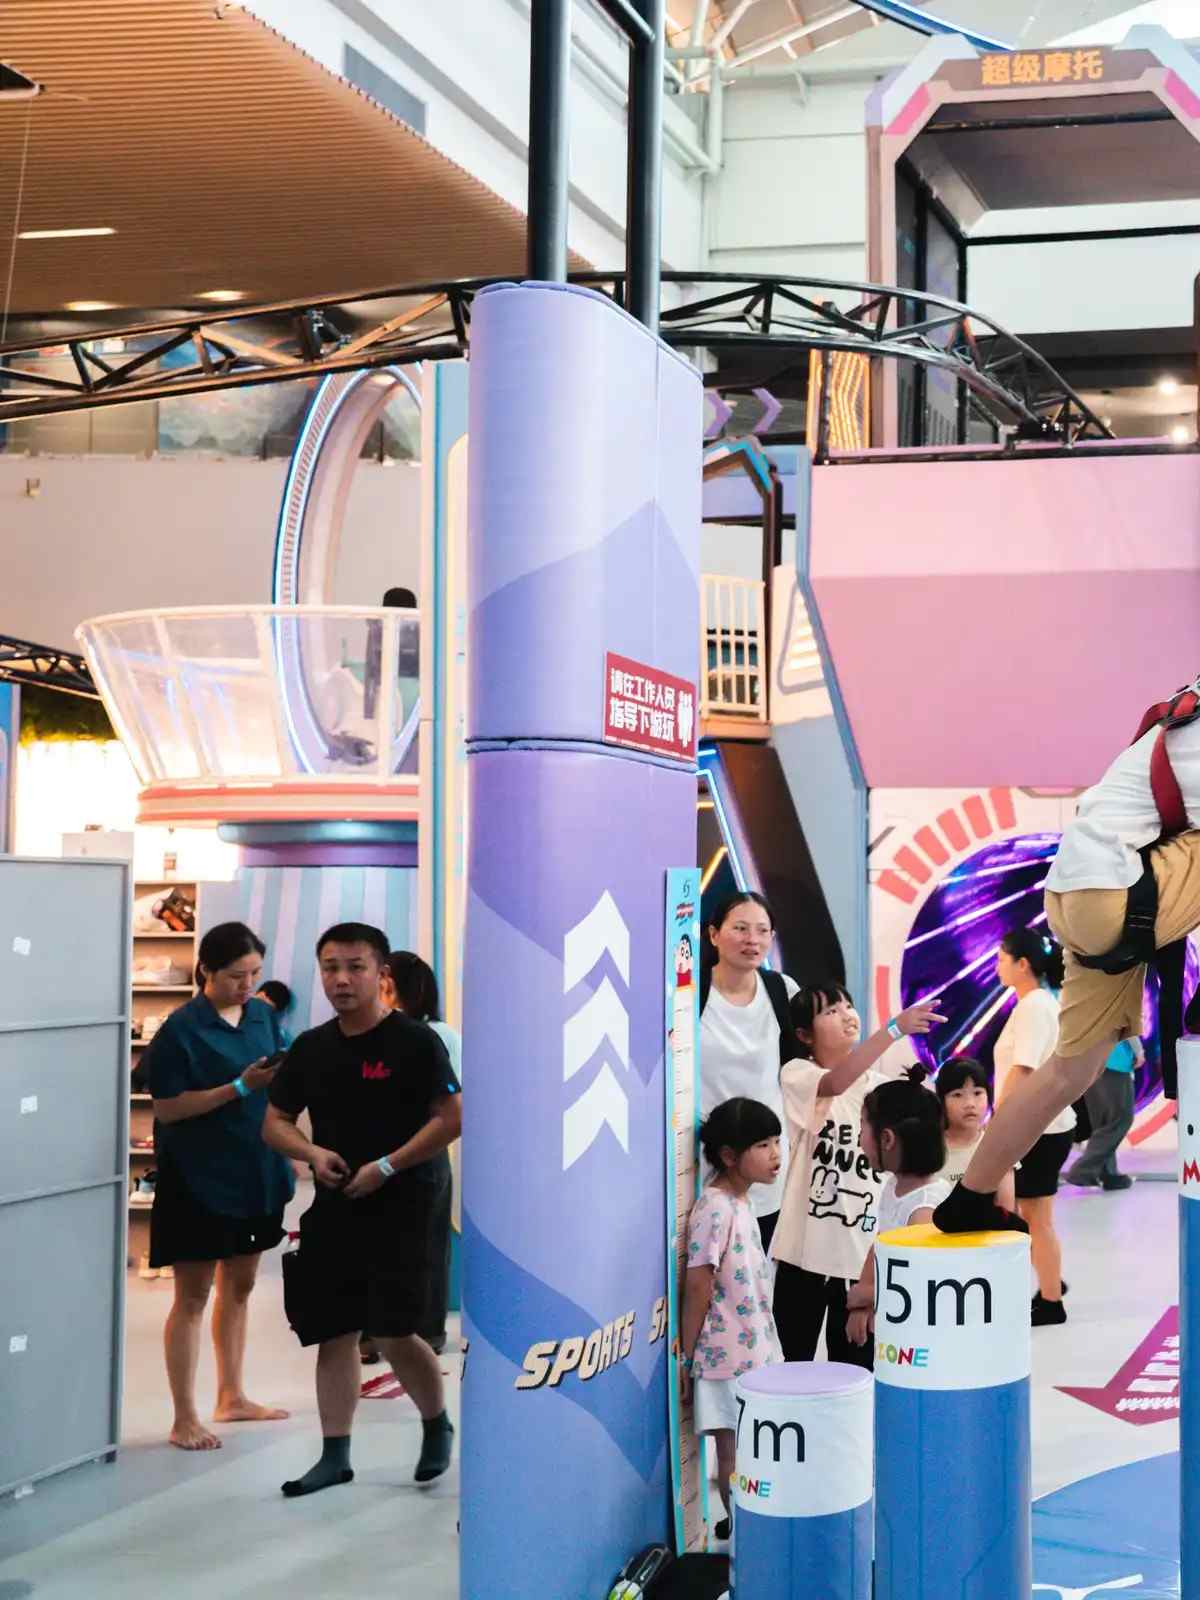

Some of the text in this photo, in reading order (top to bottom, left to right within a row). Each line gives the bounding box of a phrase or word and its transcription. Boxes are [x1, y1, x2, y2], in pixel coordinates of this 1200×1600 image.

[980, 51, 1104, 85] 超级摩托
[610, 667, 675, 711] 请在工作人员
[609, 696, 675, 742] 指导下游玩
[874, 1254, 993, 1326] 5m
[513, 1310, 637, 1389] SPORTS
